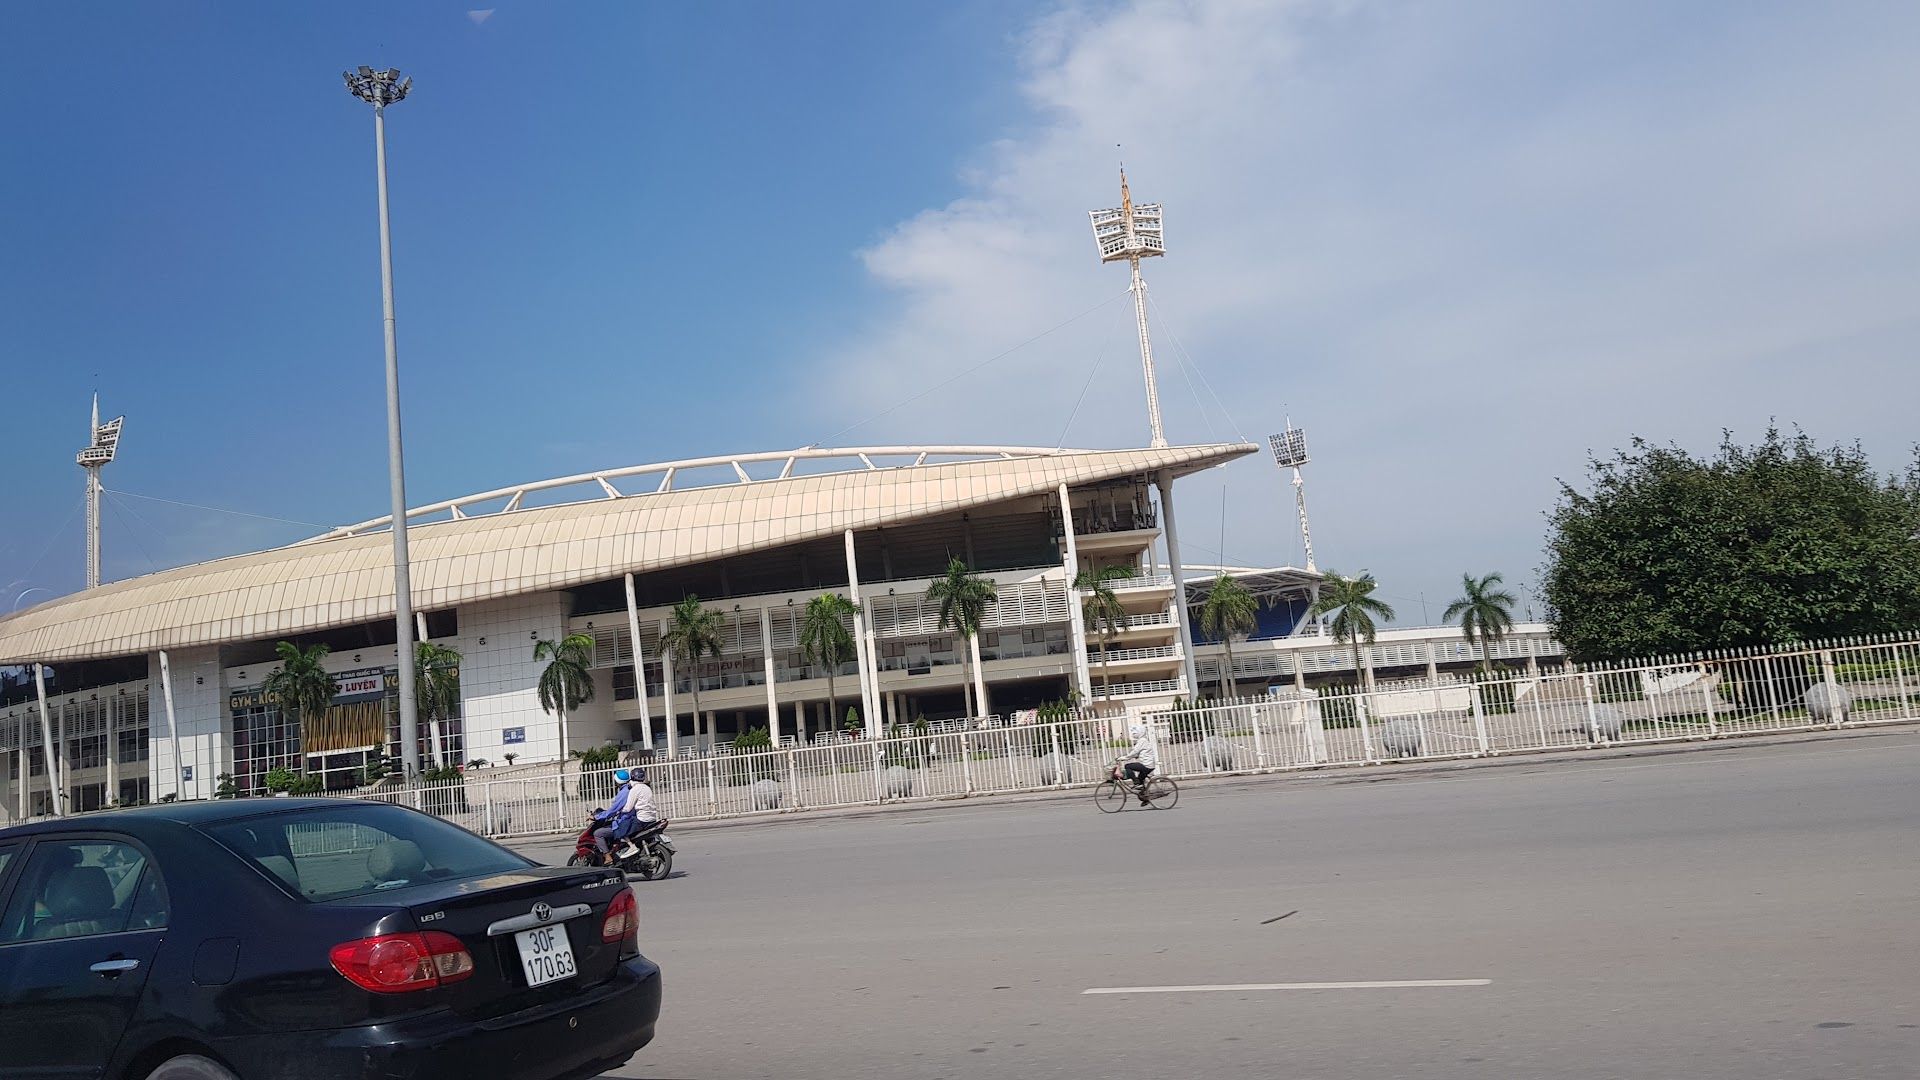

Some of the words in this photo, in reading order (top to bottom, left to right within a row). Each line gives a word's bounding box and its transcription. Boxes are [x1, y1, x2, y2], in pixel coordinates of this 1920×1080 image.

[231, 695, 252, 708] GYM
[529, 927, 555, 955] 30F
[528, 951, 573, 982] 170.63
